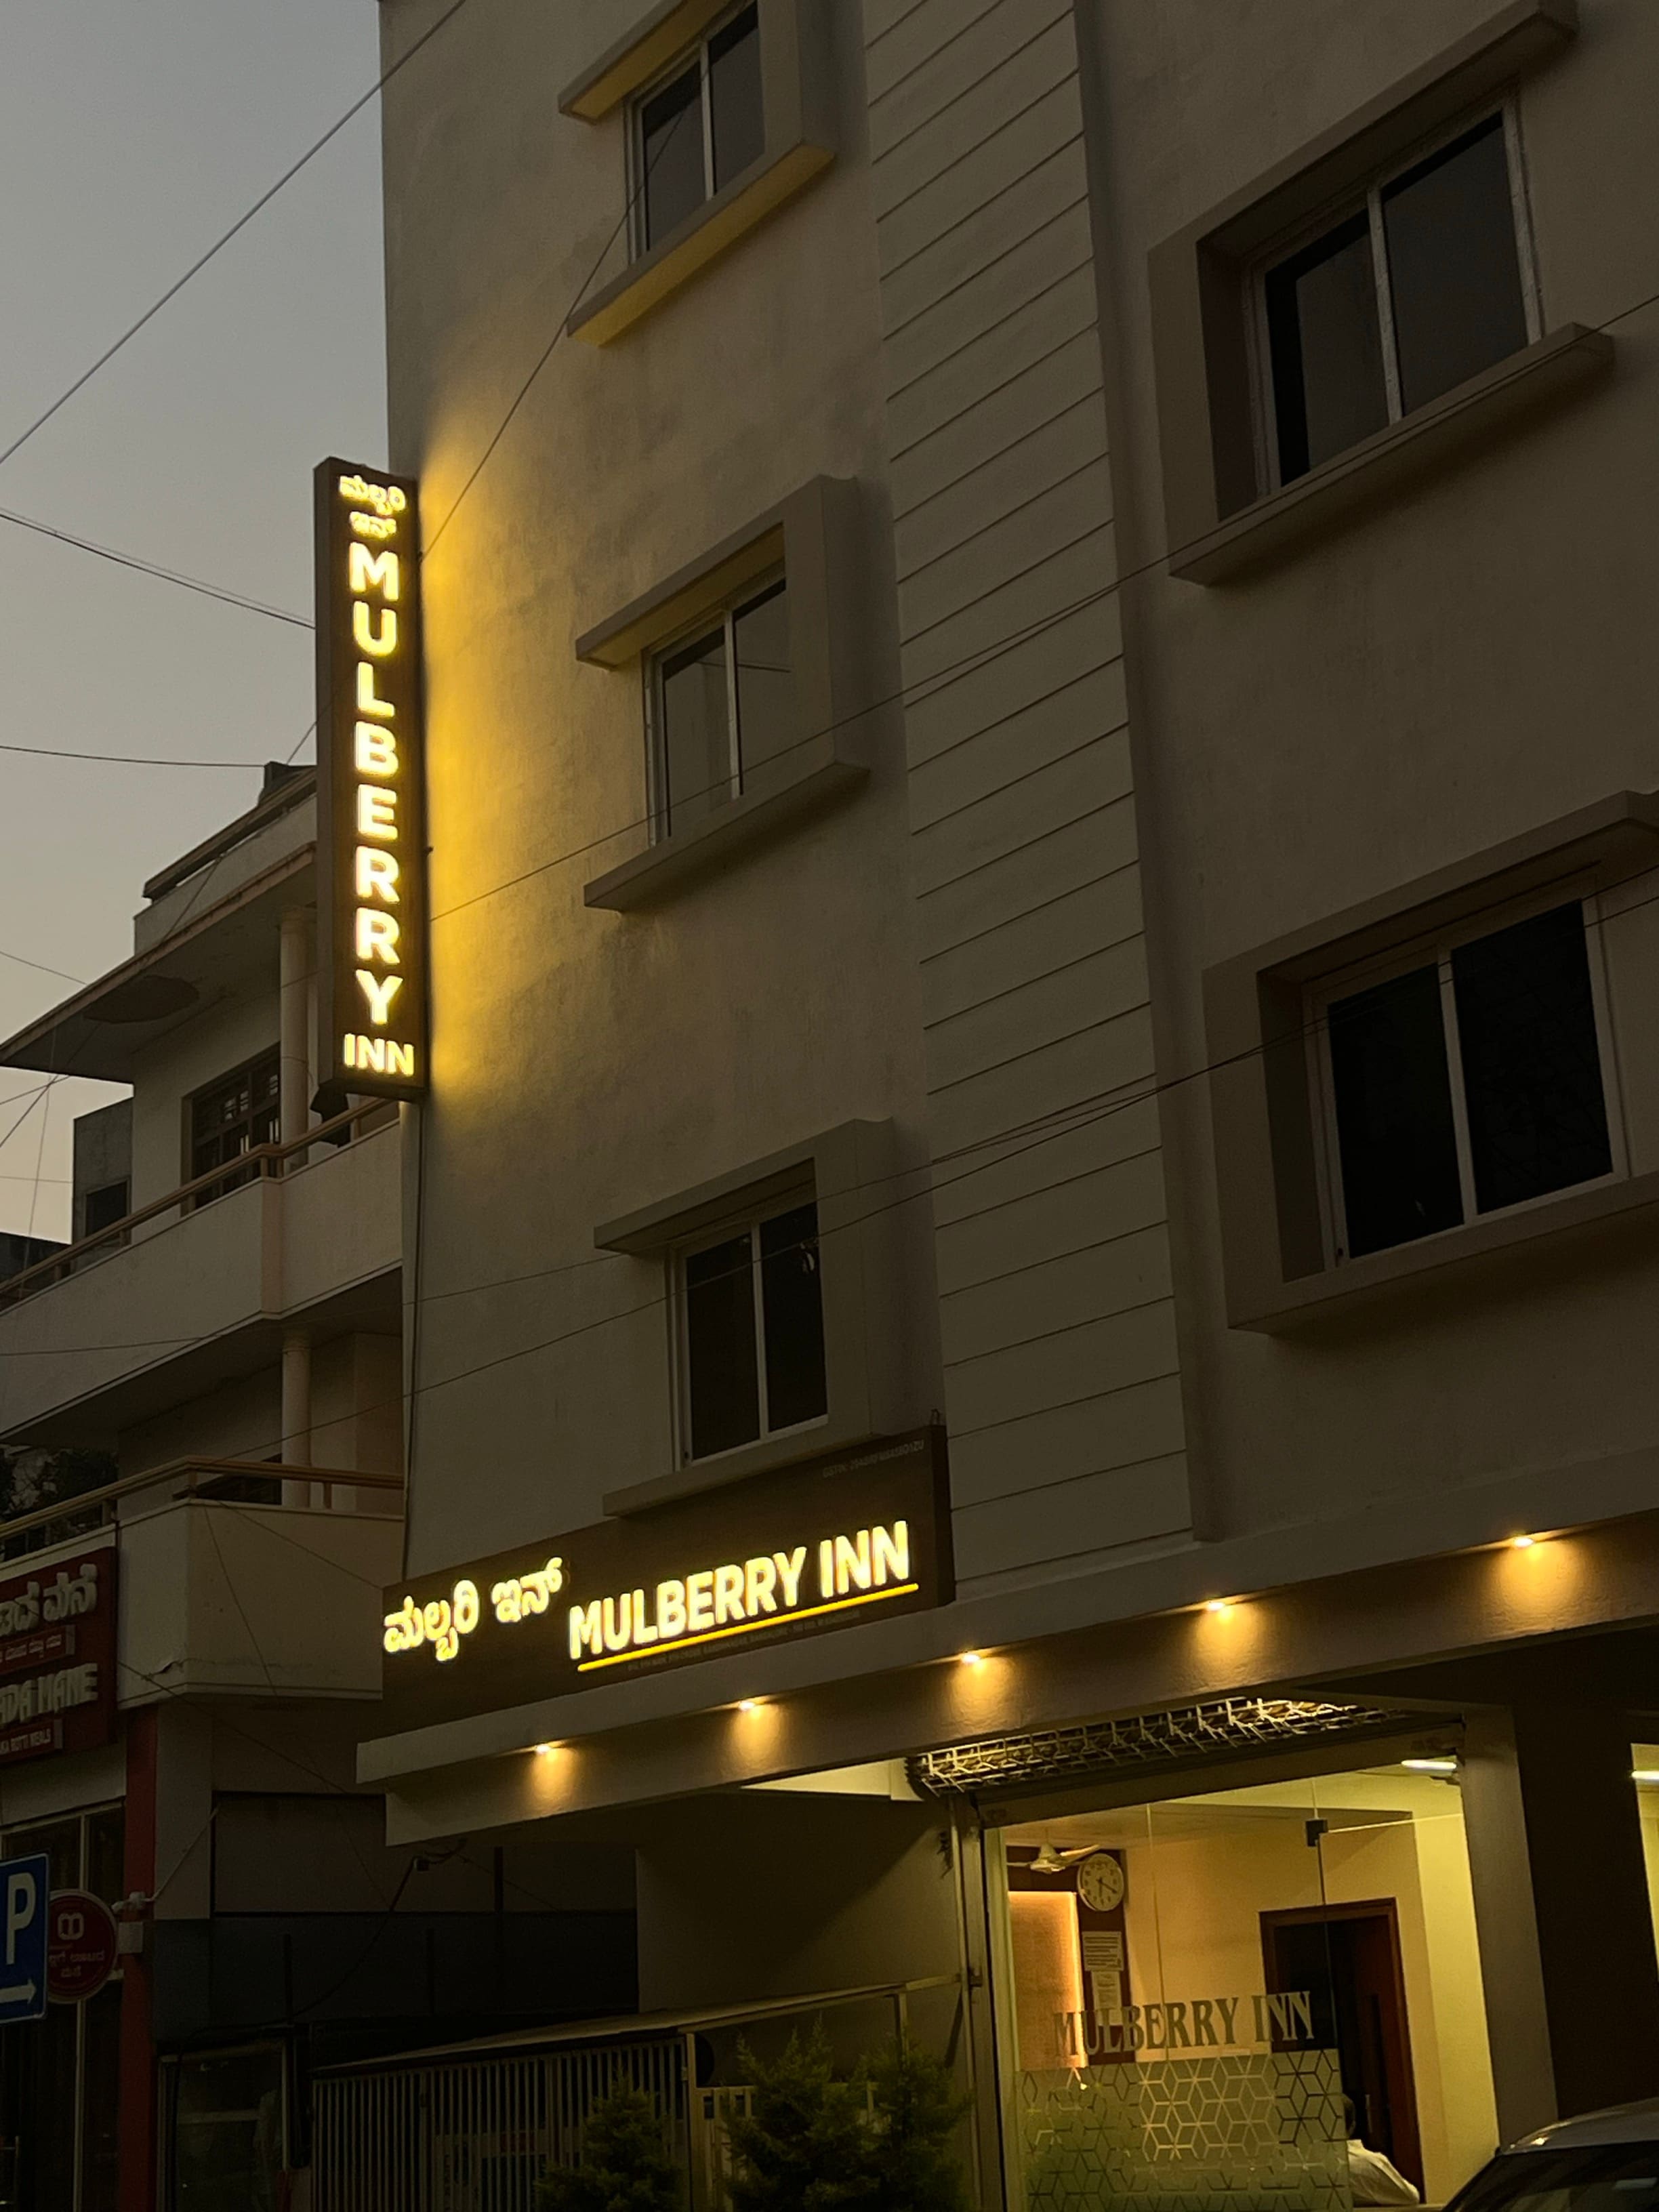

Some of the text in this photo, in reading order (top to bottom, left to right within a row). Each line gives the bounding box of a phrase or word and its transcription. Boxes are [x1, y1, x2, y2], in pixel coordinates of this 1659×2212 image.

[349, 541, 404, 1025] MULBERRY
[344, 1033, 414, 1076] INN
[492, 1557, 564, 1623] ಇನ್
[569, 1521, 910, 1660] MULBERRY INN
[37, 1663, 98, 1713] MANE
[6, 1872, 35, 1965] P
[1054, 1991, 1315, 2057] MULBERRY INN
